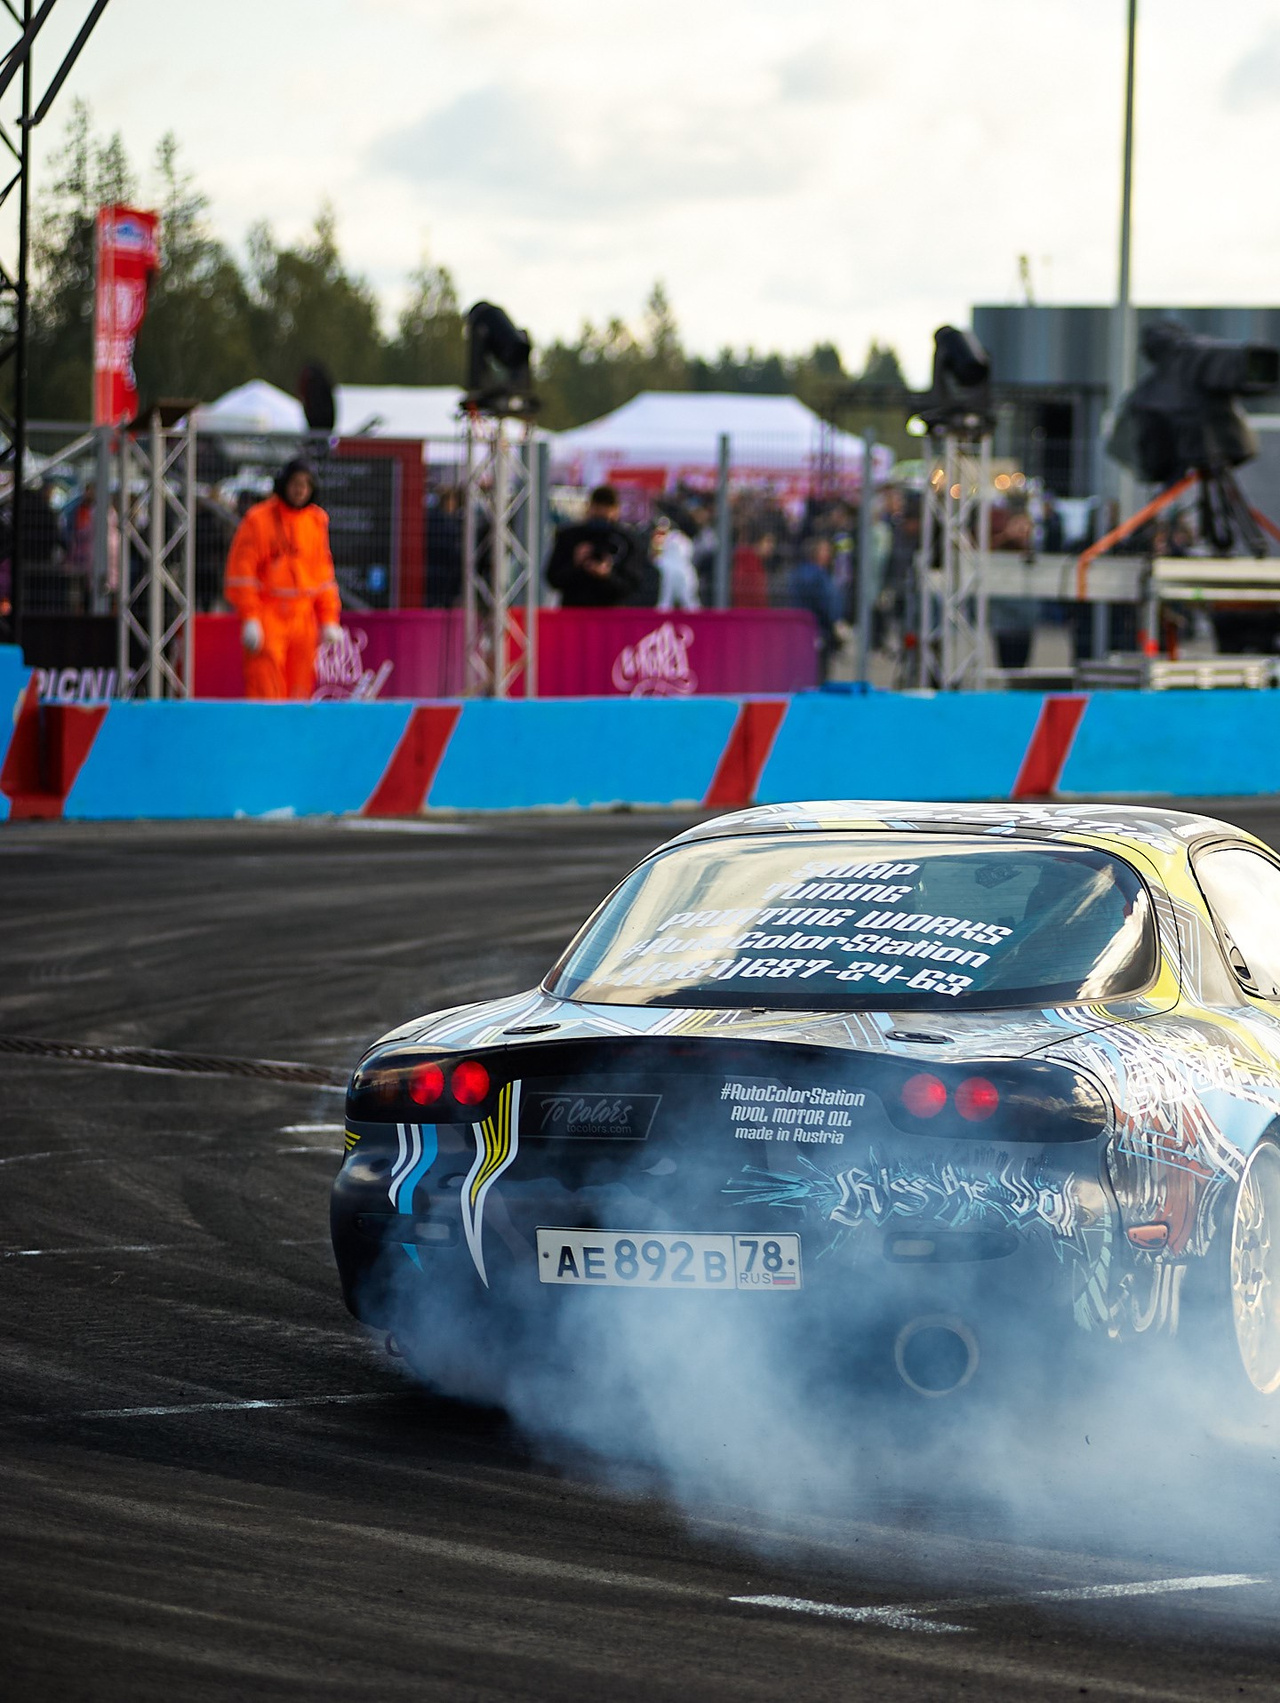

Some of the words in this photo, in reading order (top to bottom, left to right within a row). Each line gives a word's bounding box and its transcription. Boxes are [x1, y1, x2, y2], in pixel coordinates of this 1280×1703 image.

[791, 862, 920, 880] SWAP
[761, 883, 913, 904] TUNING
[656, 907, 856, 932] PAINTING
[854, 910, 1013, 946] WORKS
[720, 1082, 866, 1107] #AutoColorStation
[541, 1097, 572, 1130] To
[567, 1098, 633, 1125] Colors
[731, 1105, 769, 1123] AVOL
[771, 1107, 825, 1126] MOTOR
[827, 1110, 852, 1127] OIL
[566, 1123, 632, 1134] tocolors.com
[735, 1126, 773, 1141] made
[776, 1127, 790, 1142] in
[793, 1128, 845, 1145] Austria
[738, 1239, 783, 1273] 78
[739, 1273, 772, 1286] RUS
